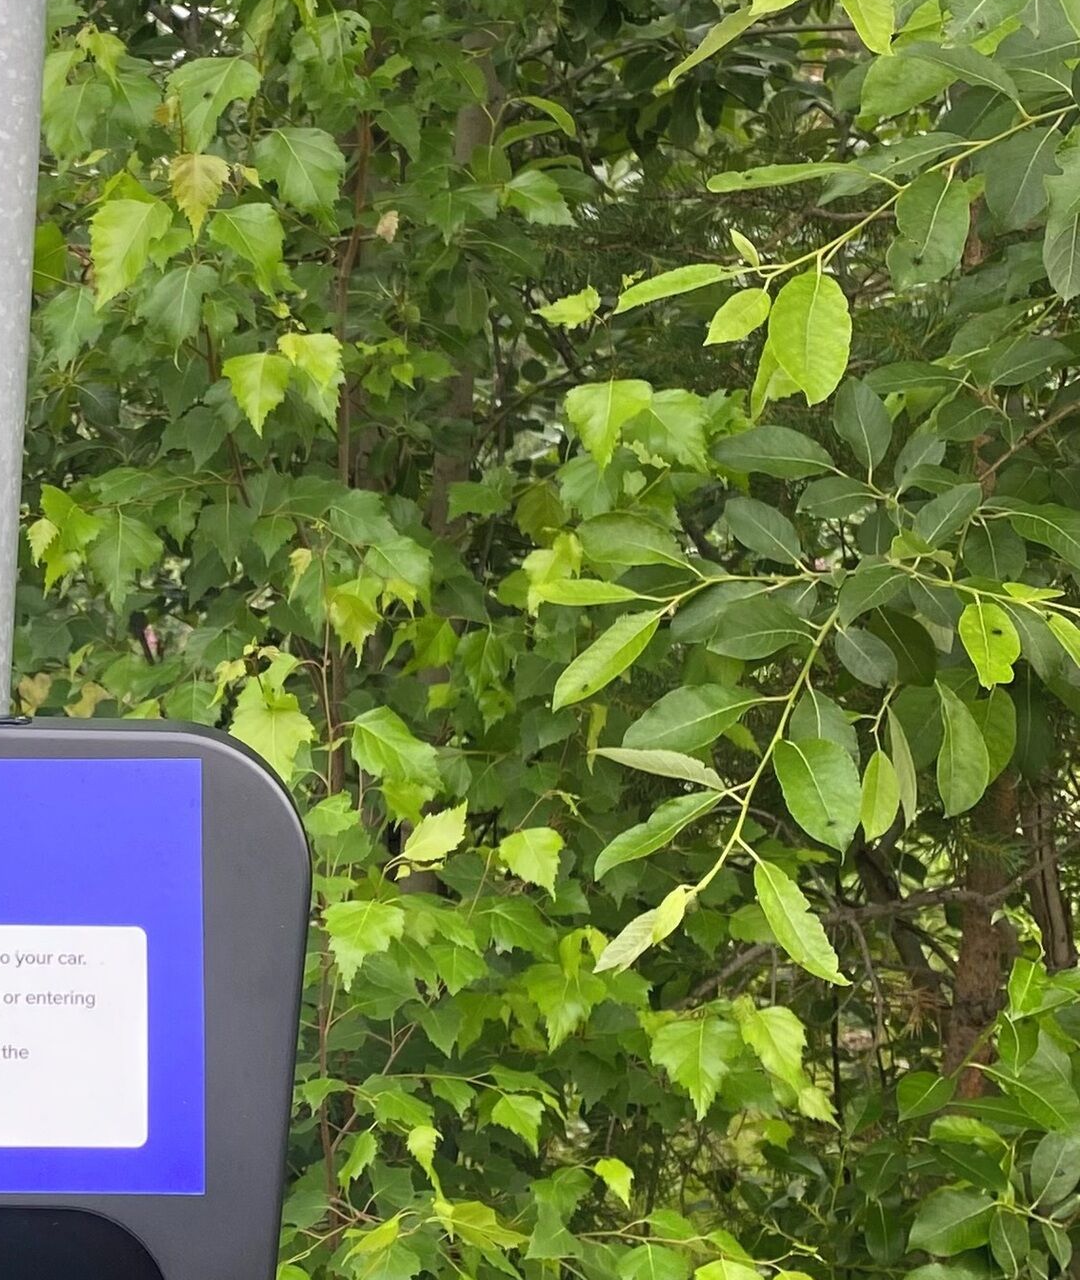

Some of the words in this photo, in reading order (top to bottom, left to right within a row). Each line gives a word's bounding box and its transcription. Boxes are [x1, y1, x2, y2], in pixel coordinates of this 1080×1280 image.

[14, 950, 54, 969] your
[57, 953, 87, 966] car.
[2, 992, 22, 1005] or
[25, 990, 96, 1010] entering
[1, 1044, 30, 1060] the
